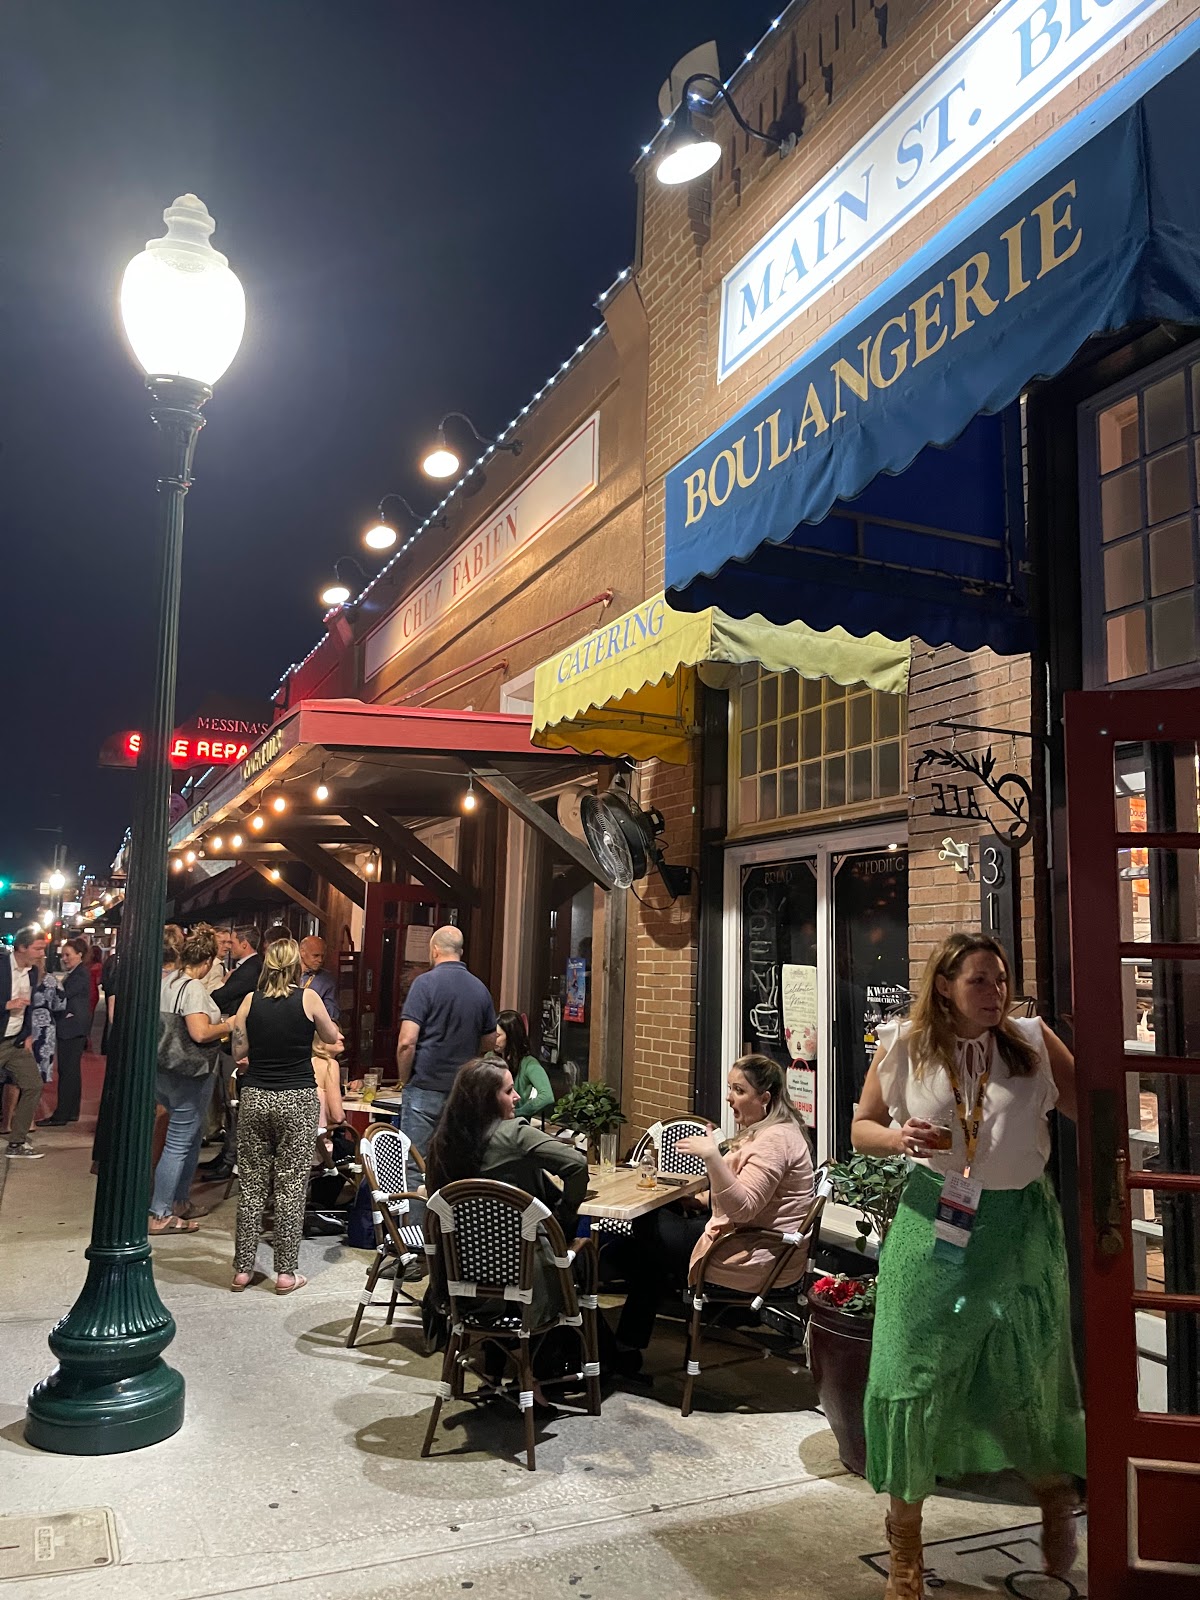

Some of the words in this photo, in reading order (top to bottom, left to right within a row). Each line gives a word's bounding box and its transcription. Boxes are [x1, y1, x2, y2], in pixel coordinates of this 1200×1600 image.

[737, 166, 876, 335] MAIN
[895, 79, 983, 189] ST.
[1012, 0, 1113, 86] BI
[683, 179, 1084, 528] BOULANGERIE
[403, 576, 443, 638] CHEZ
[451, 506, 519, 597] FABIEN
[557, 599, 665, 684] CATERING
[129, 734, 189, 757] SE
[197, 741, 248, 759] REPA
[197, 717, 269, 734] MESSINA'S
